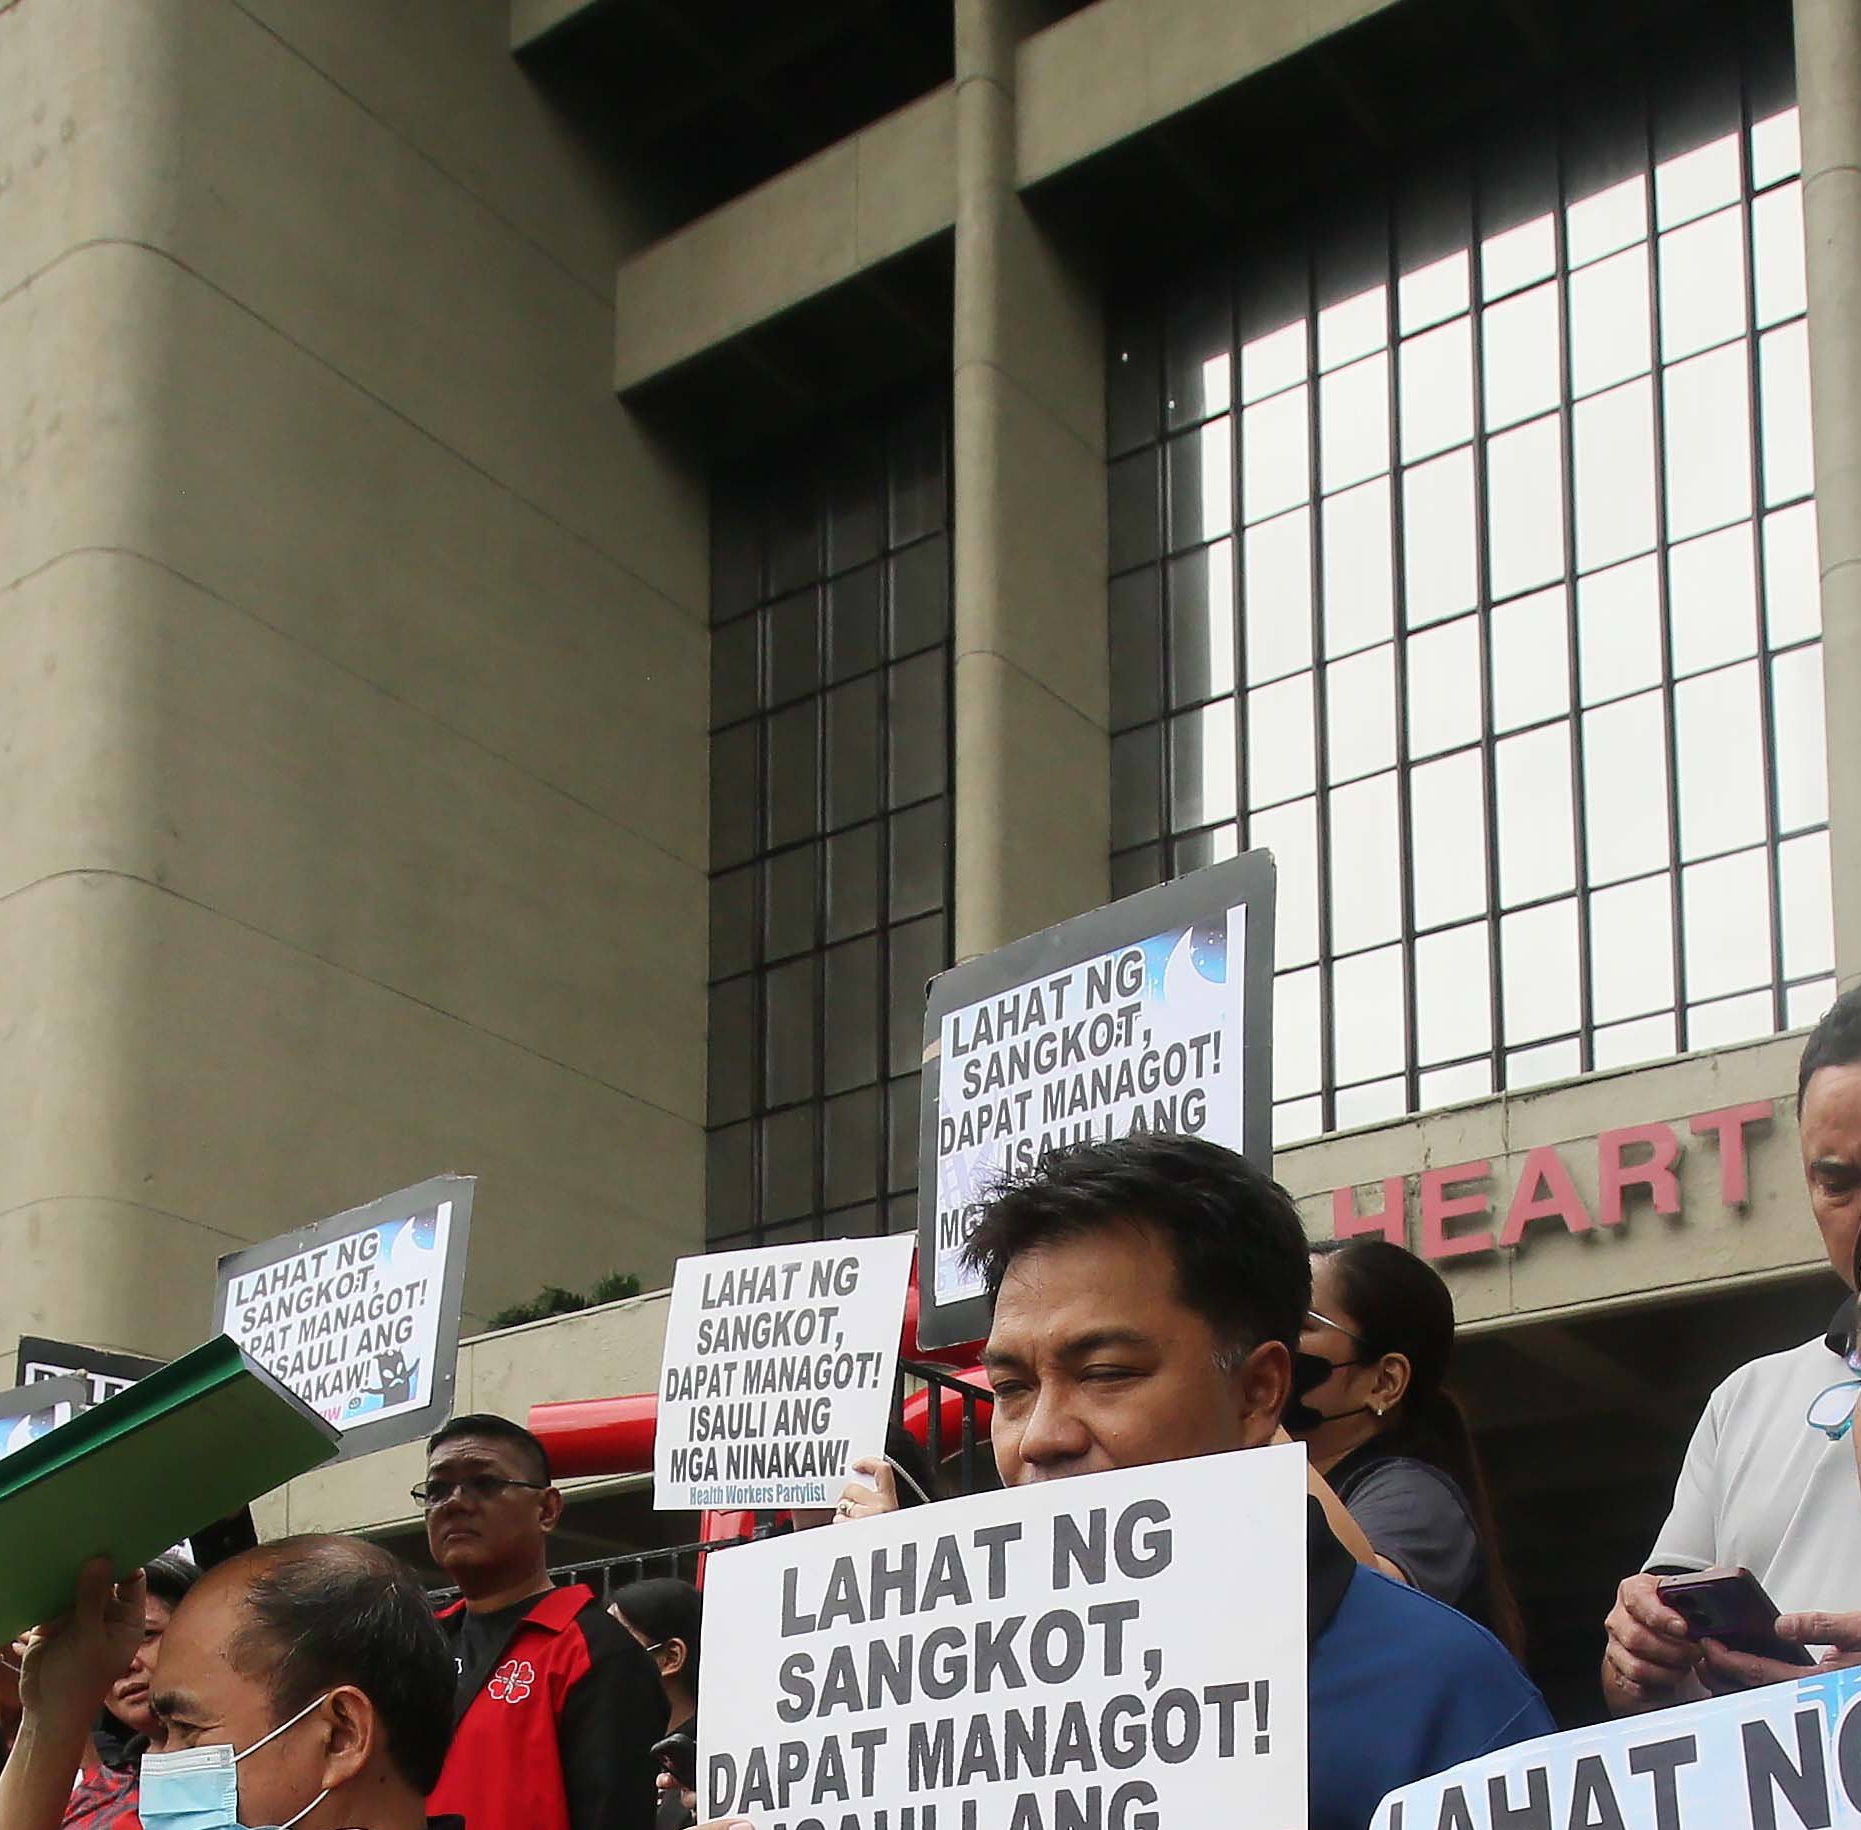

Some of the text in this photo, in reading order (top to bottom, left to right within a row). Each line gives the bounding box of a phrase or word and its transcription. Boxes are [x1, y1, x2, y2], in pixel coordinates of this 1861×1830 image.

[951, 950, 1144, 1057] LAHAT NG
[962, 1003, 1152, 1099] SANGKOT,
[940, 1030, 1223, 1156] DAPAT MANAGOT!
[1332, 1099, 1772, 1260] HEART
[236, 1232, 379, 1307] LAHAT NG
[700, 1257, 859, 1310] LAHAT NG
[298, 1279, 428, 1344] MANAGOT!
[356, 1316, 412, 1357] ANG
[697, 1307, 844, 1355] SANGKOT,
[665, 1352, 881, 1402] DAPAT MANAGOT!
[689, 1397, 831, 1442] ISAULI ANG
[670, 1443, 848, 1483] MGA NINAKAW!
[689, 1481, 827, 1506] Health Workers Partylist
[781, 1499, 1173, 1638] LAHAT NG
[775, 1600, 1162, 1723] SANGKOT,
[708, 1680, 1272, 1819] DAPAT MANAGOT!
